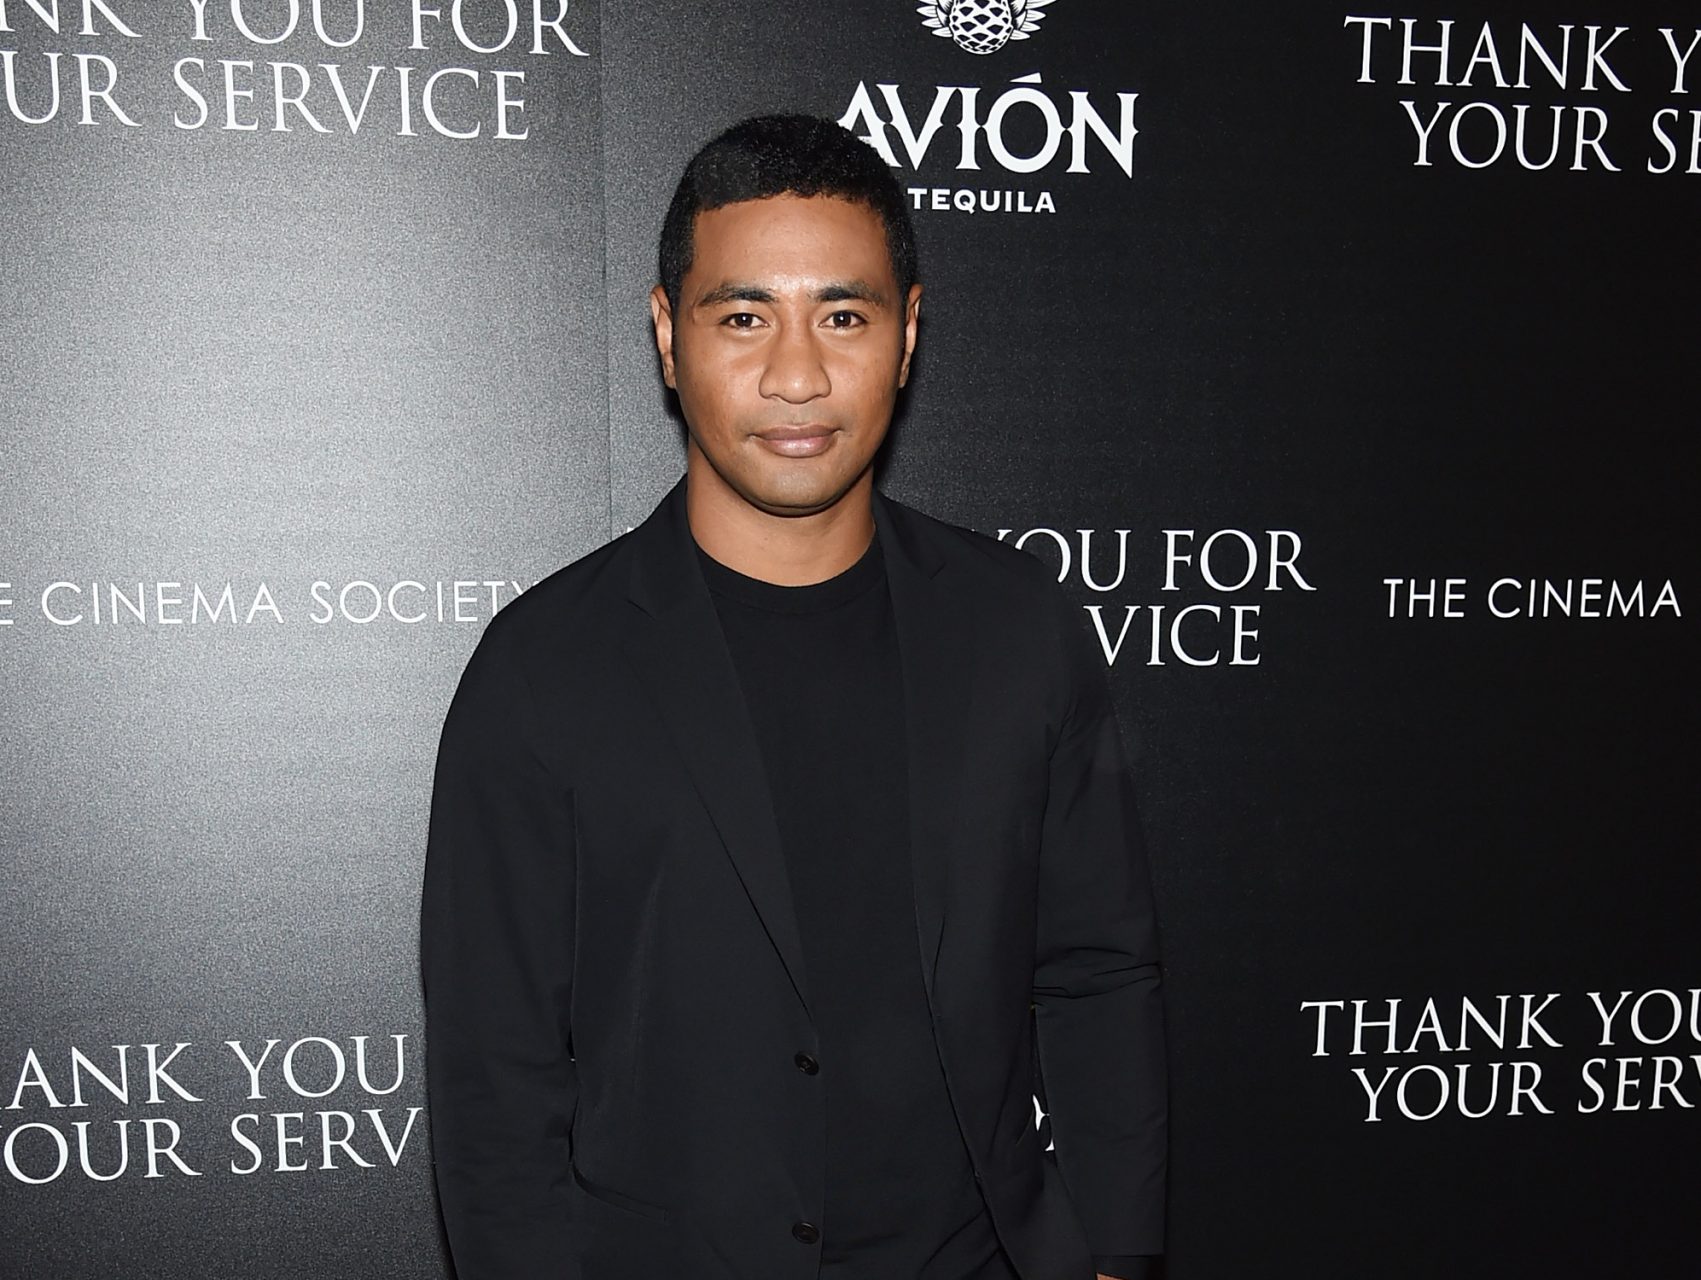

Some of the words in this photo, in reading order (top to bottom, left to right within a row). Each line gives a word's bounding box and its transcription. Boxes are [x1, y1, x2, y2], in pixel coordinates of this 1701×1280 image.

[190, 0, 364, 47] YOU
[408, 0, 589, 56] FOR
[1343, 15, 1632, 92] THANK
[174, 57, 528, 140] SERVICE
[836, 72, 1139, 179] AVIÓN
[1399, 100, 1622, 172] YOUR
[907, 187, 1056, 215] TEQUILA
[997, 528, 1132, 592] OU
[1161, 529, 1317, 592] FOR
[41, 581, 284, 625] CINEMA
[1383, 578, 1467, 618] THE
[1487, 577, 1682, 619] CINEMA
[1082, 604, 1261, 667] VICE
[1300, 993, 1564, 1057] THANK
[0, 1042, 203, 1110] ANK
[224, 1034, 408, 1100] YOU
[1351, 1061, 1555, 1122] YOUR
[1577, 1054, 1701, 1114] SER
[0, 1118, 202, 1184] OUR
[231, 1107, 423, 1174] SERV
